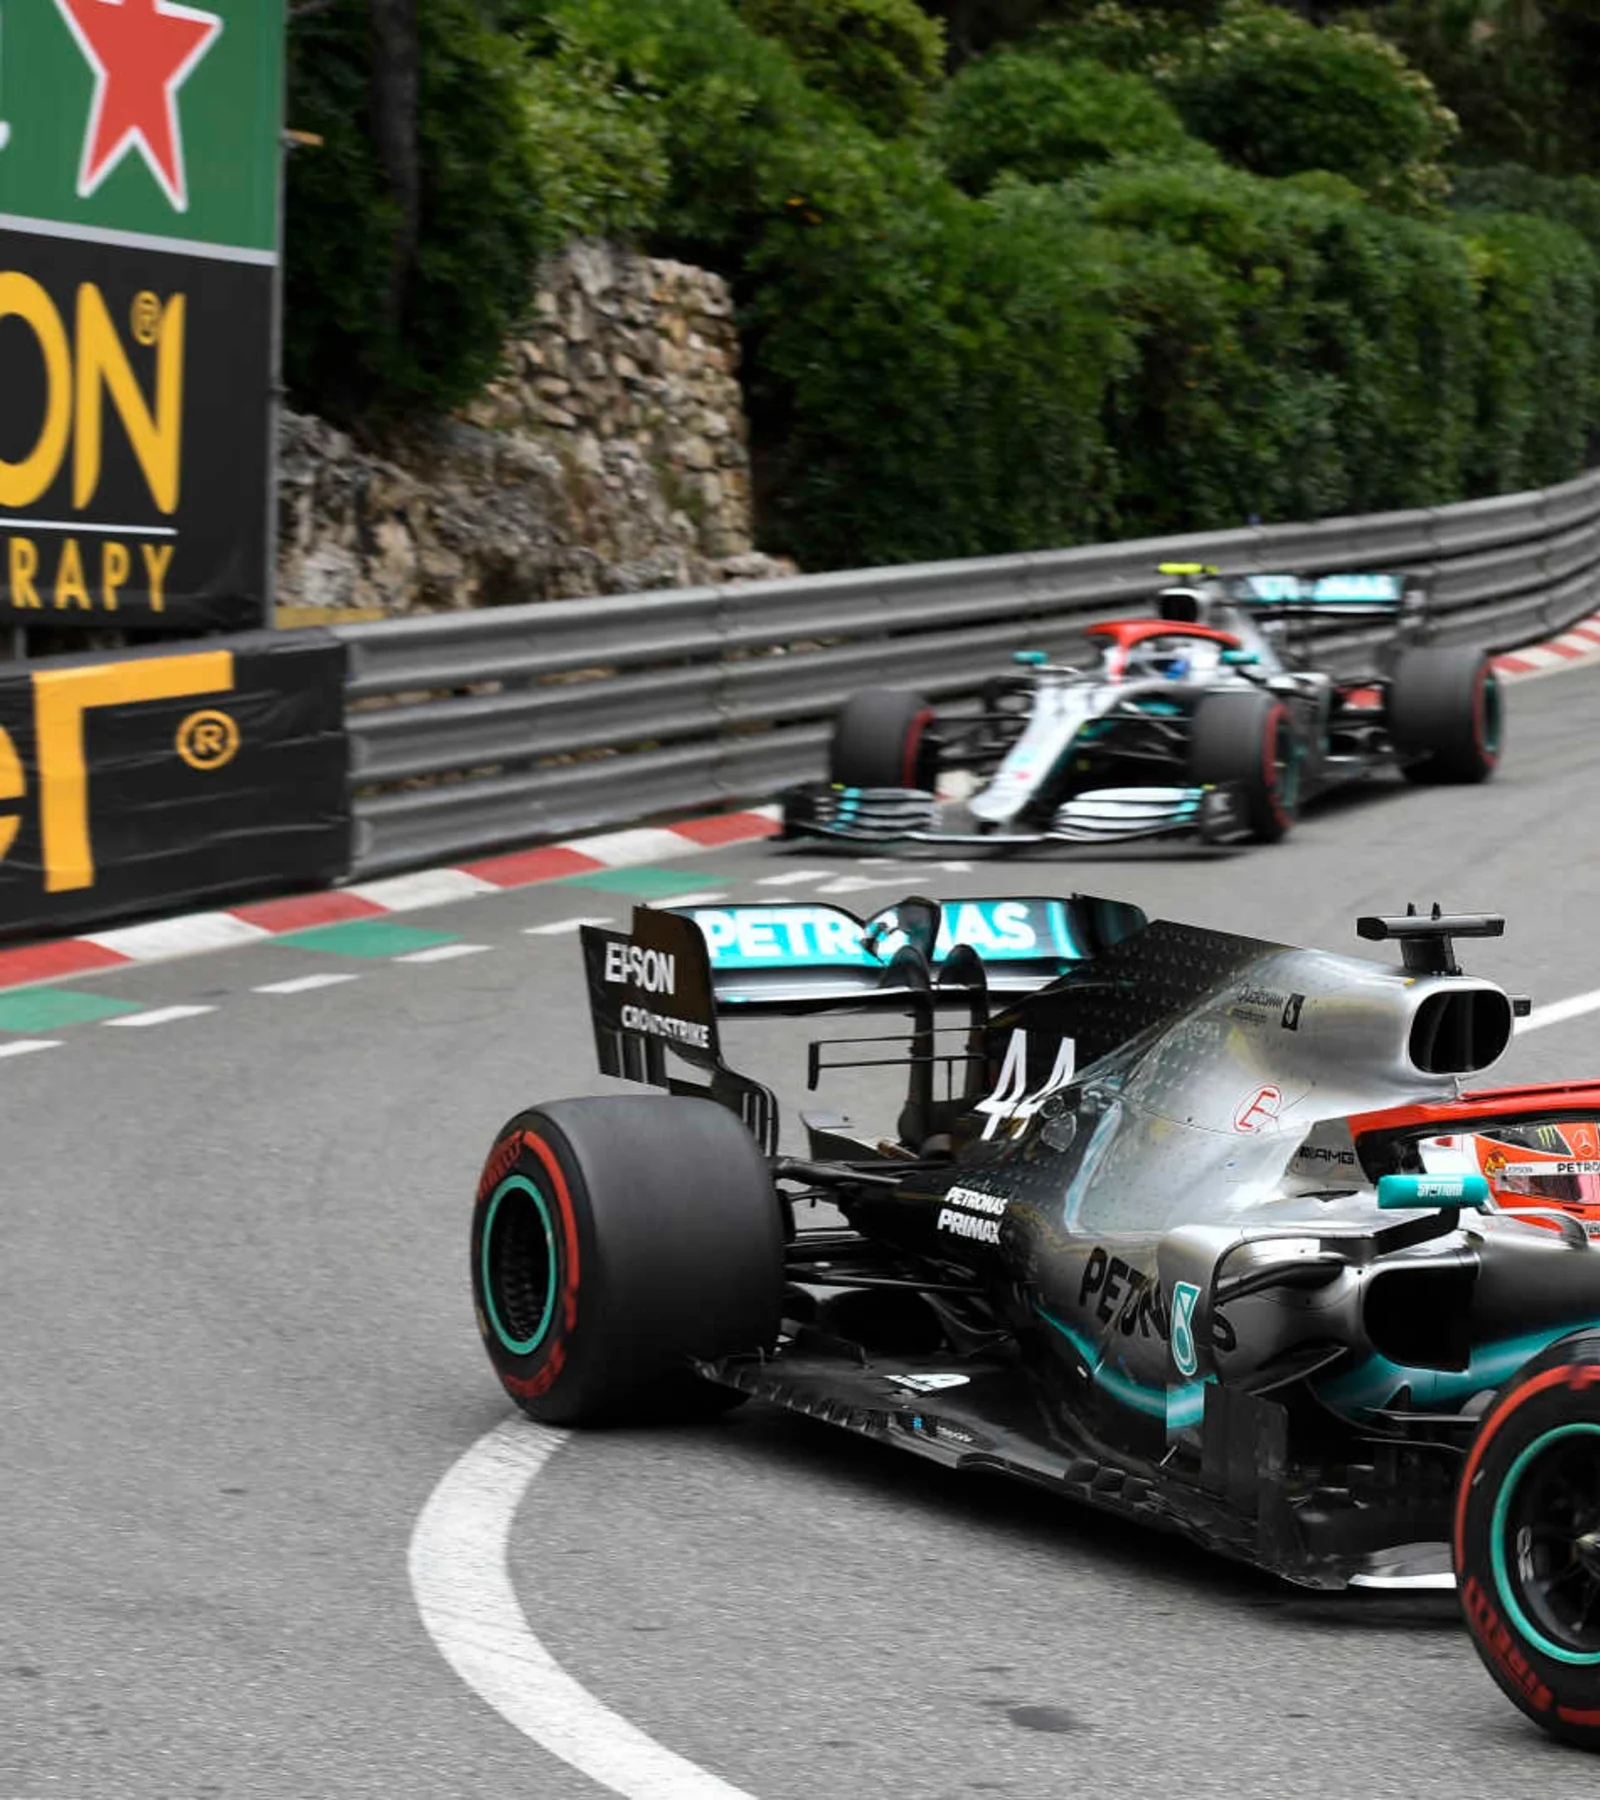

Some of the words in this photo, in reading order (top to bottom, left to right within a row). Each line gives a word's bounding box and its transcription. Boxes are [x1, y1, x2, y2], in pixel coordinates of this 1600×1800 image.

[605, 941, 675, 995] EPSON
[974, 1028, 1075, 1140] 44
[944, 1186, 1008, 1215] PETRONAS
[937, 1208, 1001, 1245] PRIMAX
